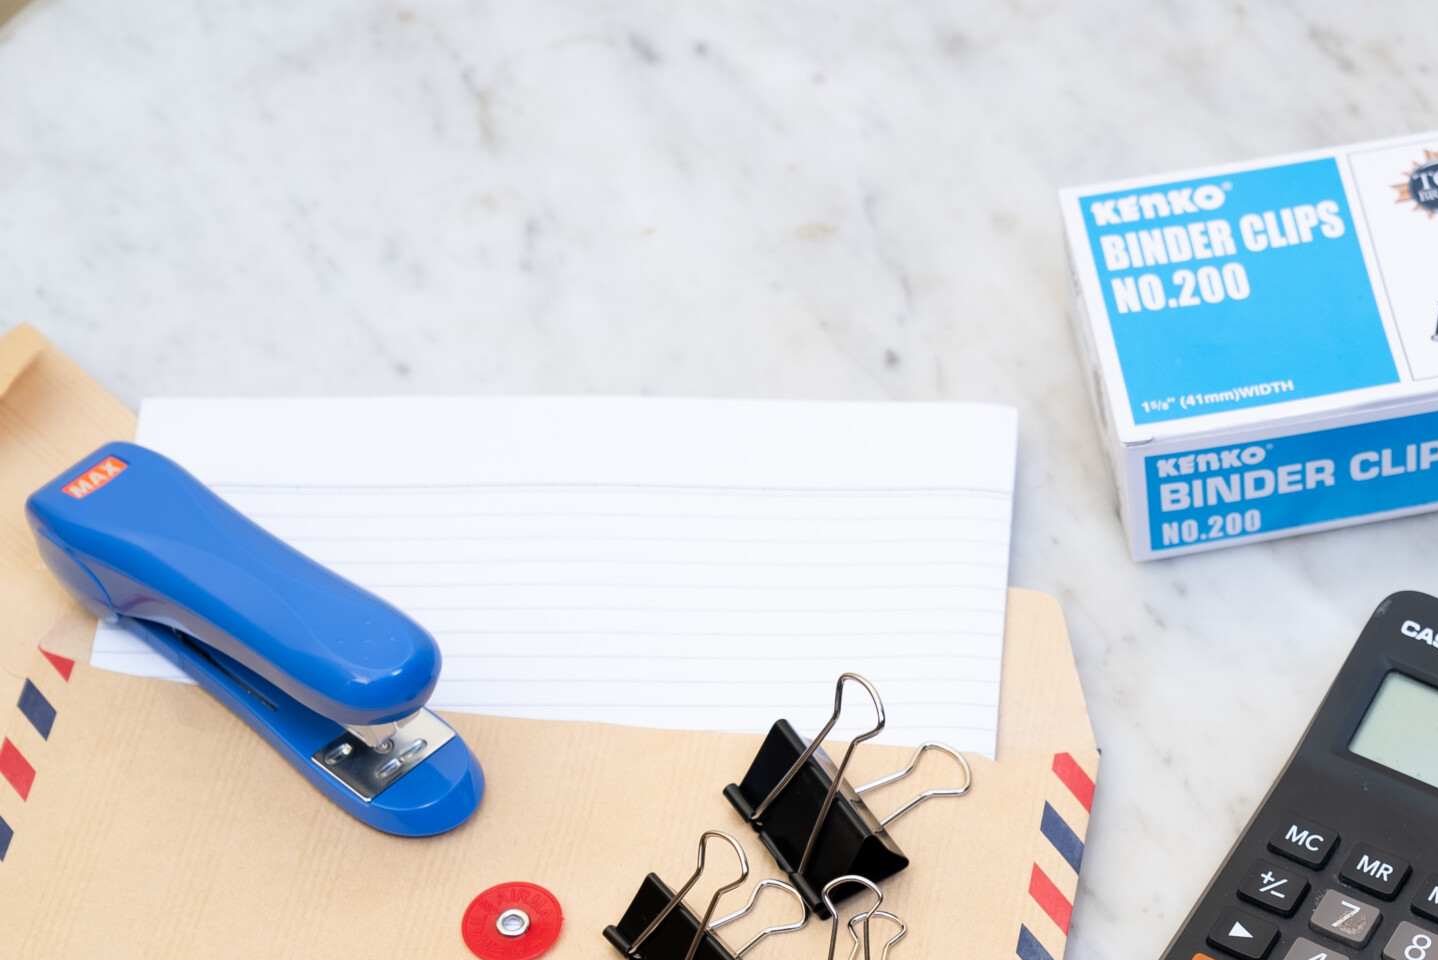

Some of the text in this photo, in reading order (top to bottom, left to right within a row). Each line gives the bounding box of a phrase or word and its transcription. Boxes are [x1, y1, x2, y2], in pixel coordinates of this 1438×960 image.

[1100, 200, 1346, 271] BINDER CLIPS
[1111, 262, 1251, 314] NO.200
[69, 461, 120, 498] MAX
[1160, 459, 1336, 513] BINDER
[1162, 509, 1262, 546] NO.200
[1285, 825, 1324, 851] MC
[1356, 855, 1394, 882] MR
[1331, 900, 1361, 928] 7
